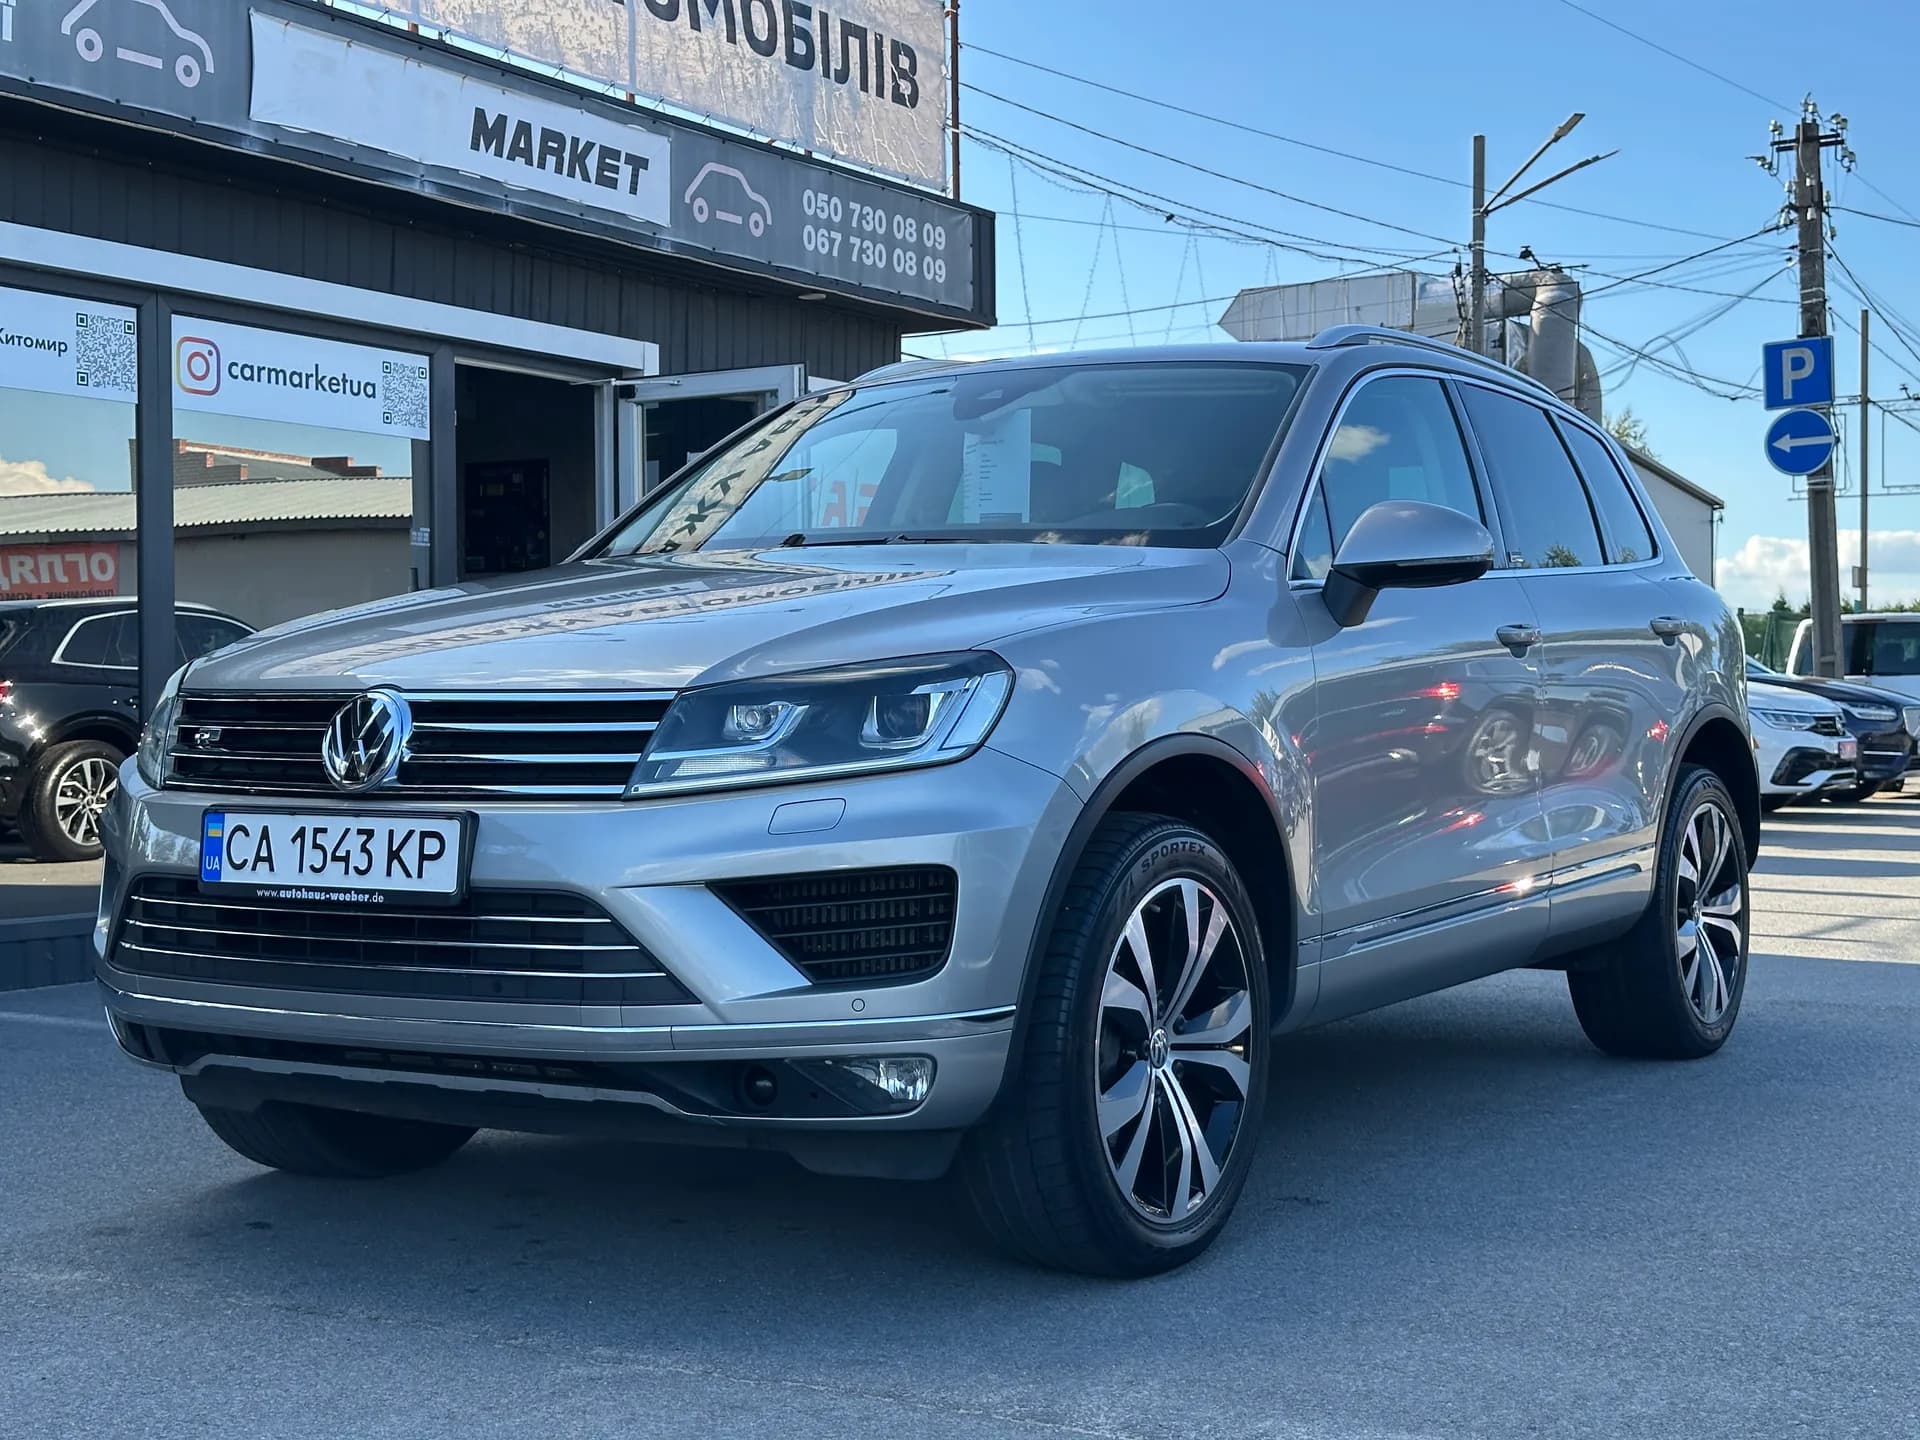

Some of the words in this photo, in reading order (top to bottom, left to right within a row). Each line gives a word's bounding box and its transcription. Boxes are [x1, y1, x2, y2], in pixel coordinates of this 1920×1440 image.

[611, 0, 919, 109] МОБІЛІВ
[470, 106, 650, 196] MARKET
[803, 189, 842, 223] 050
[850, 202, 887, 235] 730
[893, 214, 917, 243] 08
[923, 222, 946, 250] 09
[803, 225, 842, 257] 067
[850, 236, 887, 269] 730
[893, 248, 917, 276] 08
[923, 255, 946, 283] 09
[227, 360, 377, 399] carmarketua
[1782, 347, 1815, 400] P
[205, 856, 221, 871] UA
[226, 824, 275, 873] CA
[291, 826, 375, 876] 1543
[386, 829, 446, 879] KP
[1141, 841, 1207, 873] SPORTEX
[256, 888, 384, 903] www.autohaus-weeber.de
